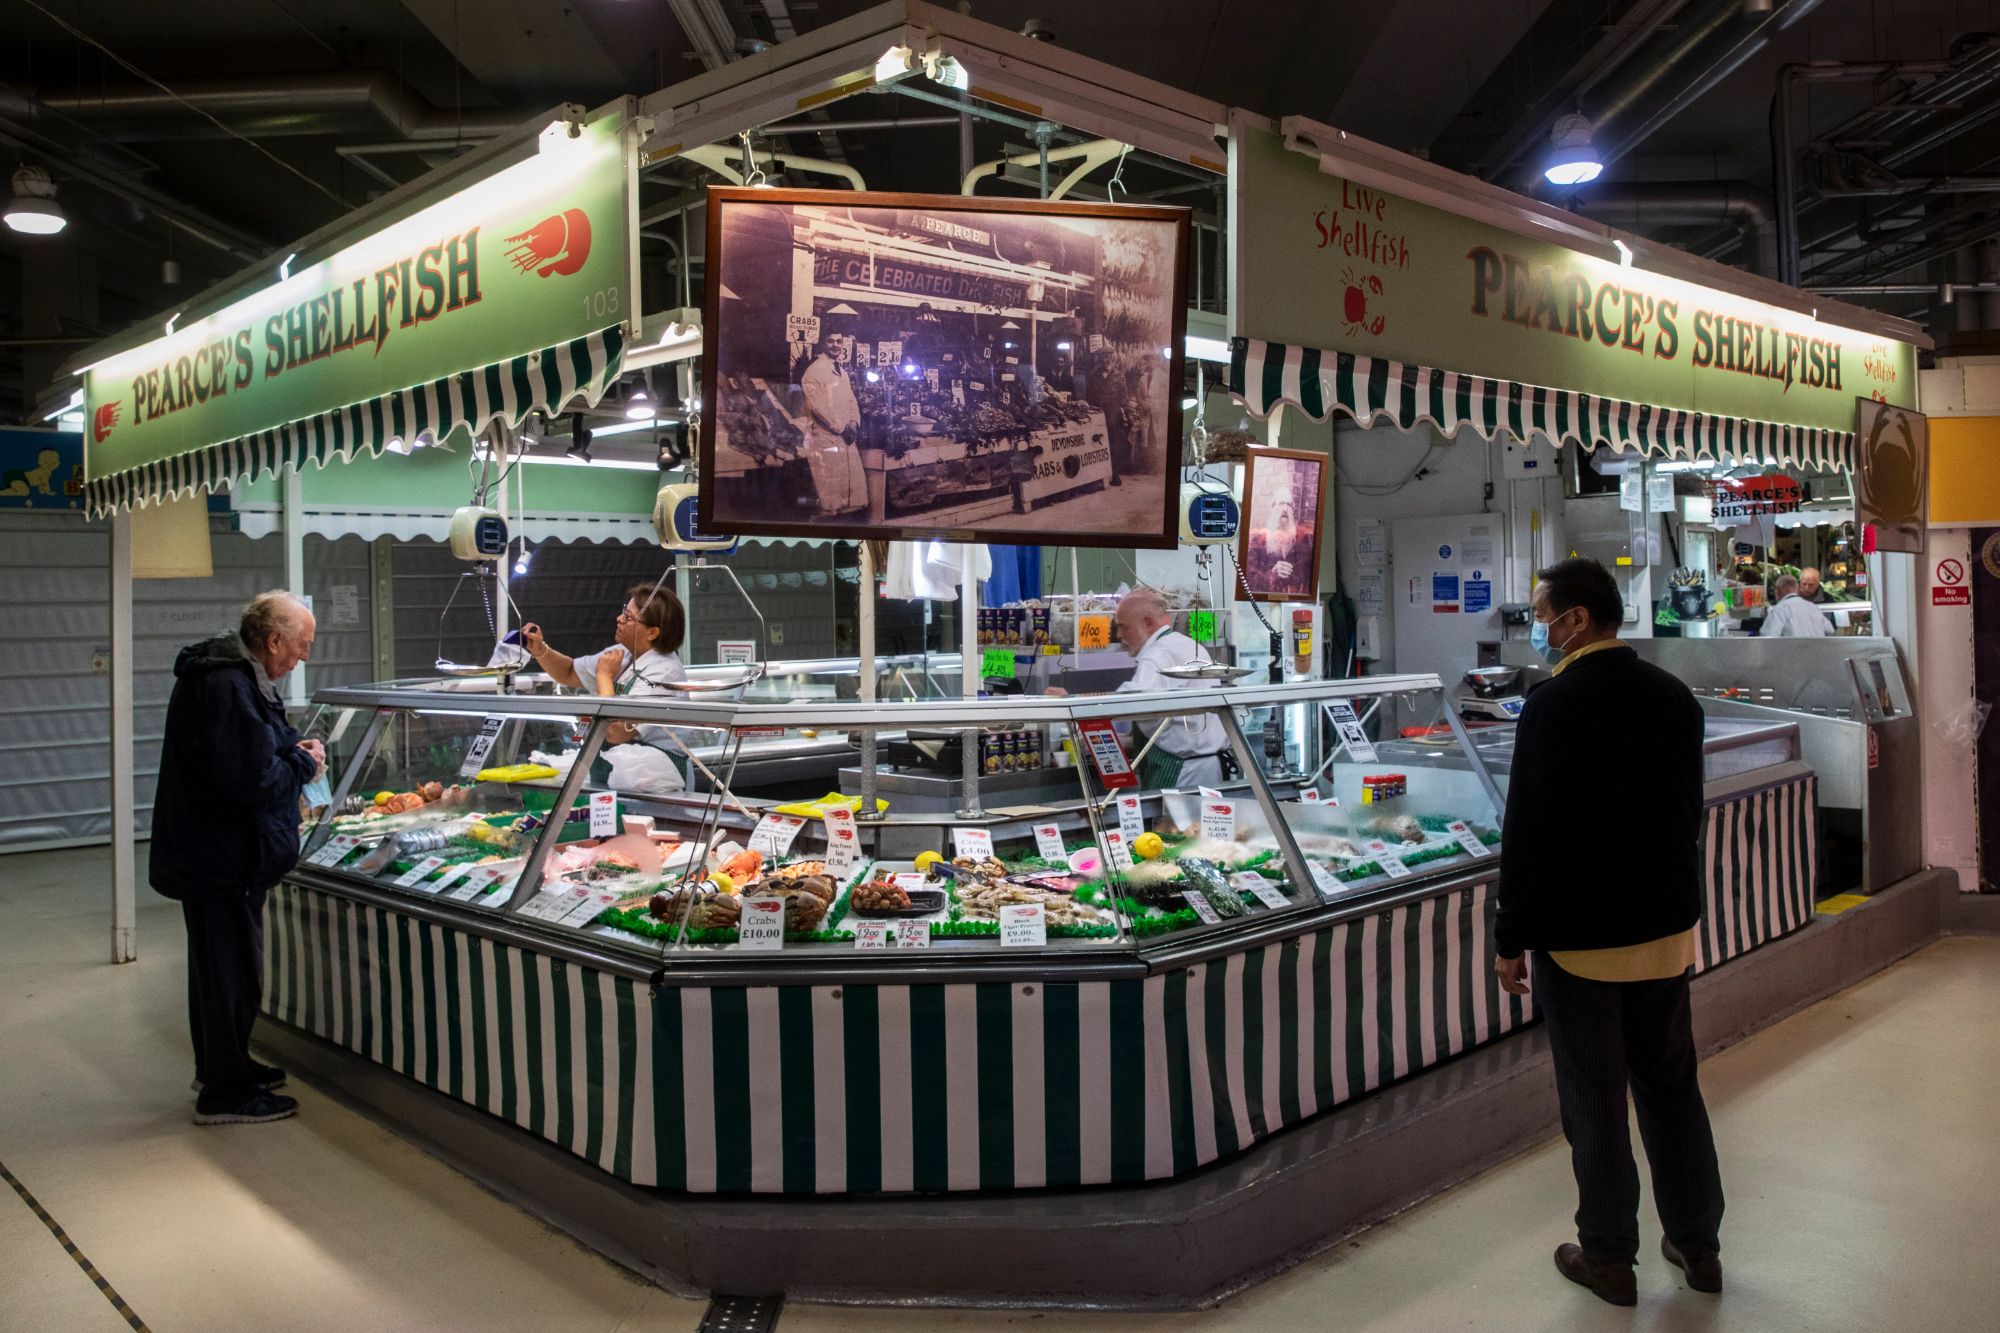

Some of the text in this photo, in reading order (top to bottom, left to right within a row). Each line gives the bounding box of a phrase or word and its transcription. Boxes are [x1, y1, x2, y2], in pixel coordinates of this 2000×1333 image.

[1342, 181, 1387, 222] Live
[1314, 209, 1410, 270] Shellfish
[845, 260, 953, 295] CELEBRATED
[582, 287, 620, 321] 103
[131, 226, 482, 426] PEARCE'S SHELLFISH
[790, 315, 817, 326] CRABS
[1467, 244, 1843, 395] PEARCE'S SHELLFISH
[1864, 354, 1896, 384] Shellfish
[1051, 434, 1086, 451] DEVONSHIRE
[1034, 461, 1055, 480] RABS
[1080, 448, 1110, 467] LOBSTERS
[1711, 501, 1801, 519] SHELLFISH
[1719, 486, 1800, 504] PEARCE'S
[1934, 596, 1968, 604] smoking
[742, 929, 780, 939] £10.00
[748, 916, 777, 925] Crabs
